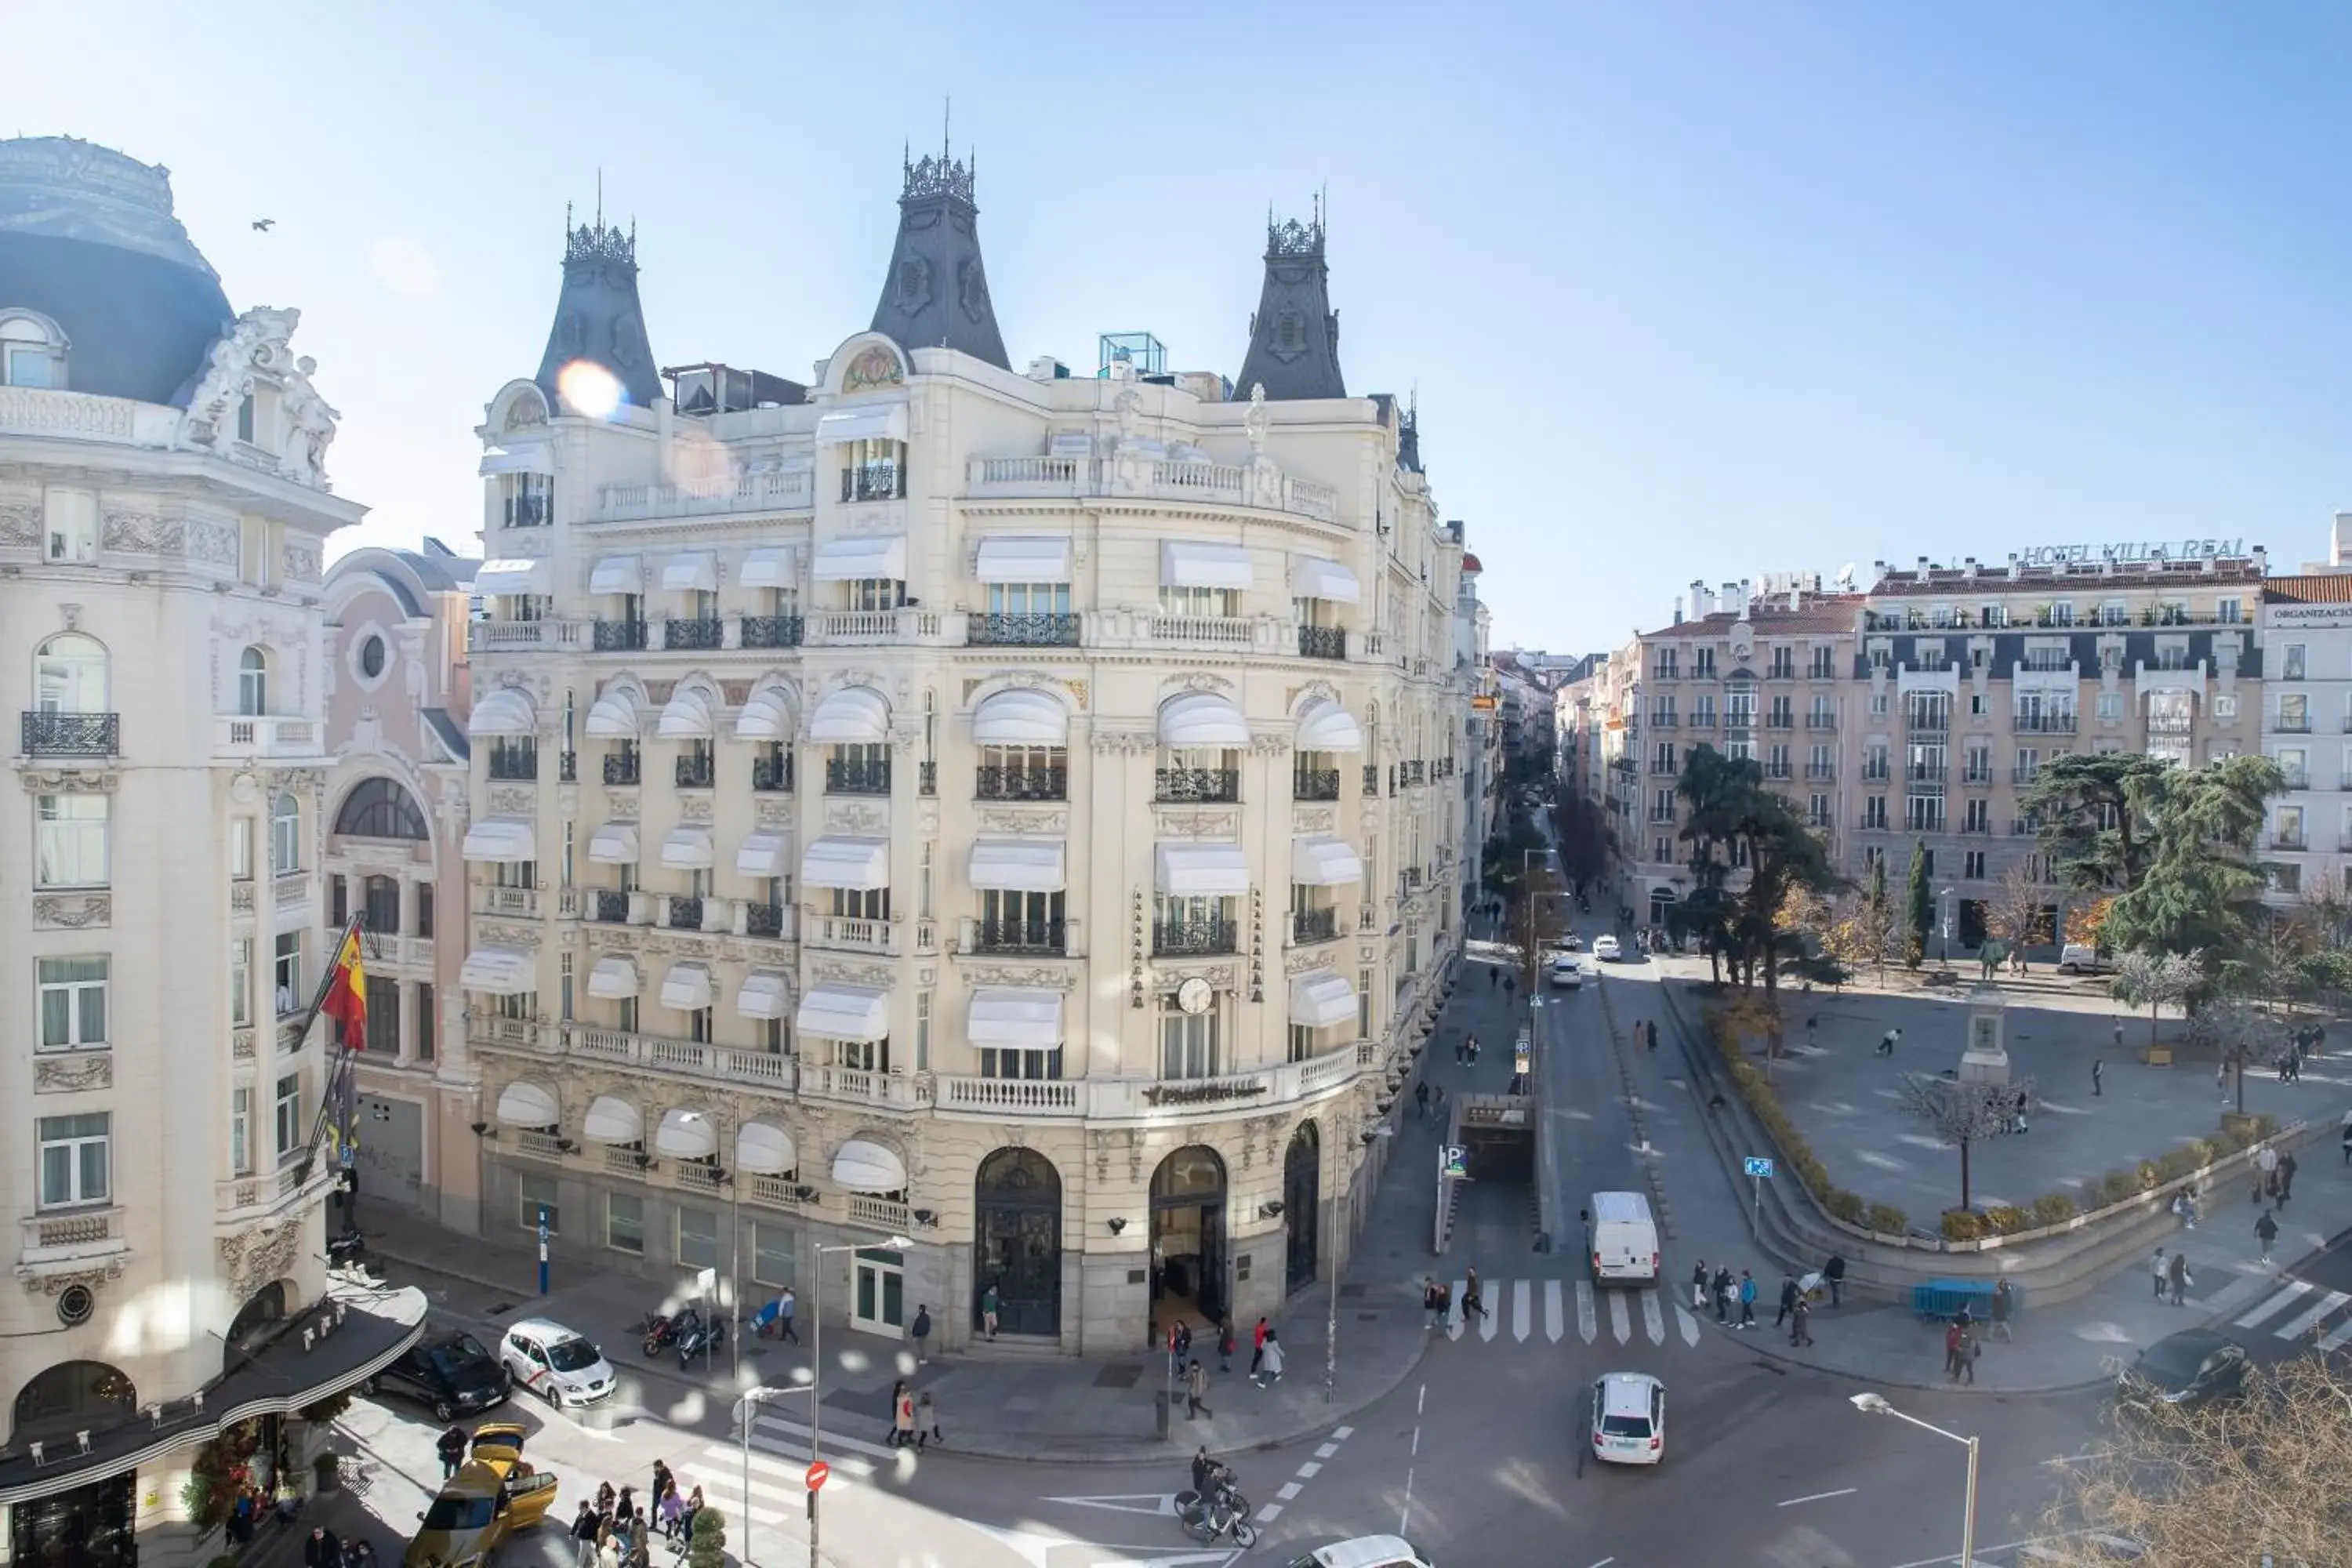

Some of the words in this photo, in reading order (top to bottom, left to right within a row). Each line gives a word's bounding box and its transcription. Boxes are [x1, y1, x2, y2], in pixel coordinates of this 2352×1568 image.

[2024, 544, 2092, 564] HOTEL
[2102, 541, 2169, 561] VILLA
[2182, 538, 2245, 558] REAL
[1448, 1147, 1461, 1167] P
